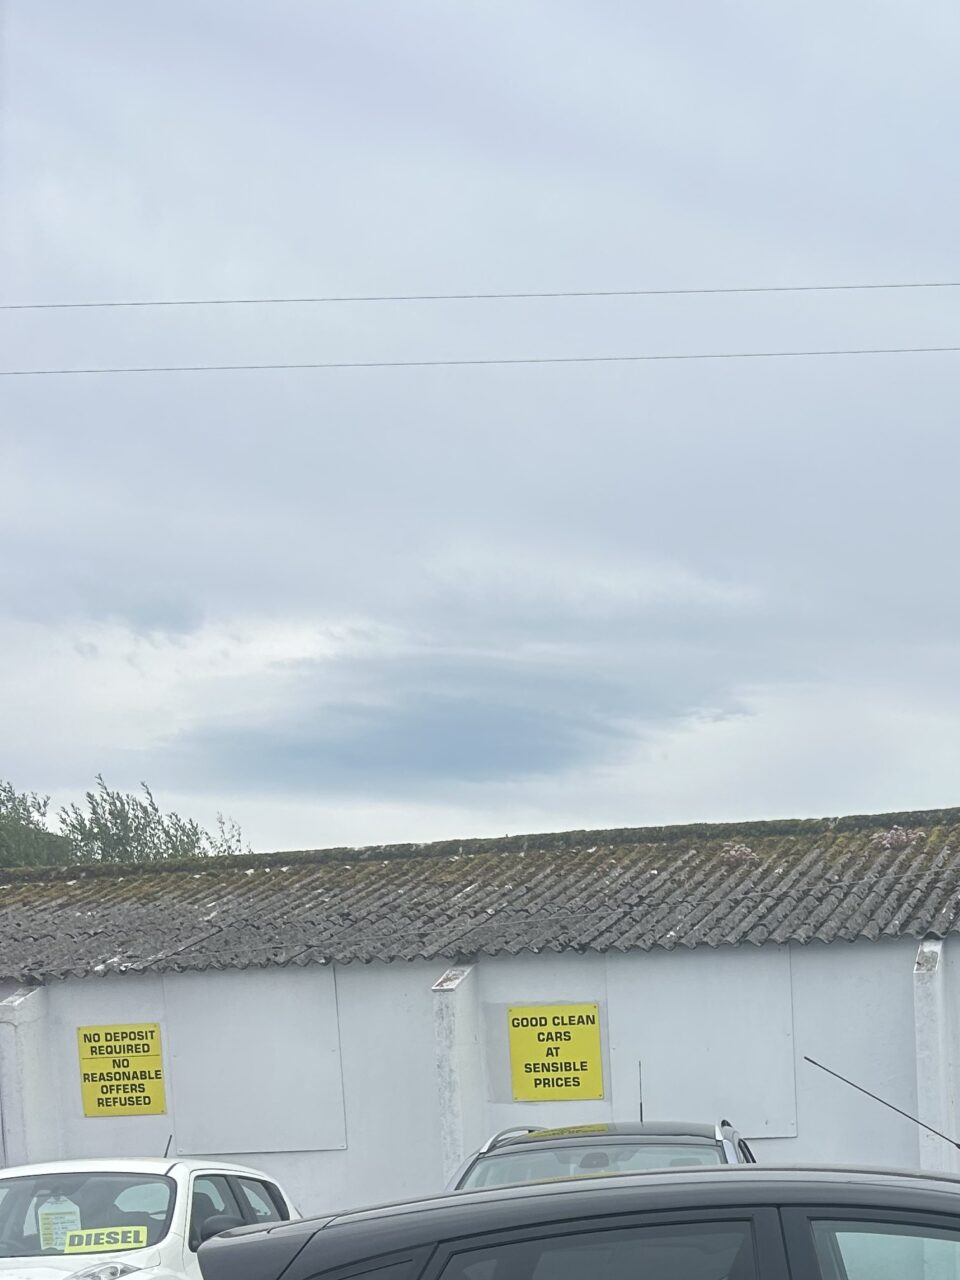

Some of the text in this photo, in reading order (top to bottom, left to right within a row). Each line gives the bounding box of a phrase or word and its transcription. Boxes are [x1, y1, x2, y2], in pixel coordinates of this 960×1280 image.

[511, 1014, 596, 1028] GOOD CLEAN
[83, 1030, 155, 1043] NO DEPOSIT
[537, 1031, 571, 1042] CARS
[90, 1043, 150, 1056] REQUIRED
[545, 1046, 560, 1057] AT
[112, 1058, 130, 1068] NO
[524, 1061, 588, 1073] SENSIBLE
[83, 1069, 162, 1083] REASONABLE
[534, 1076, 581, 1088] PRICES
[100, 1083, 145, 1095] OFFERS
[97, 1095, 151, 1107] REFUSED
[68, 1230, 143, 1247] DIESEL
